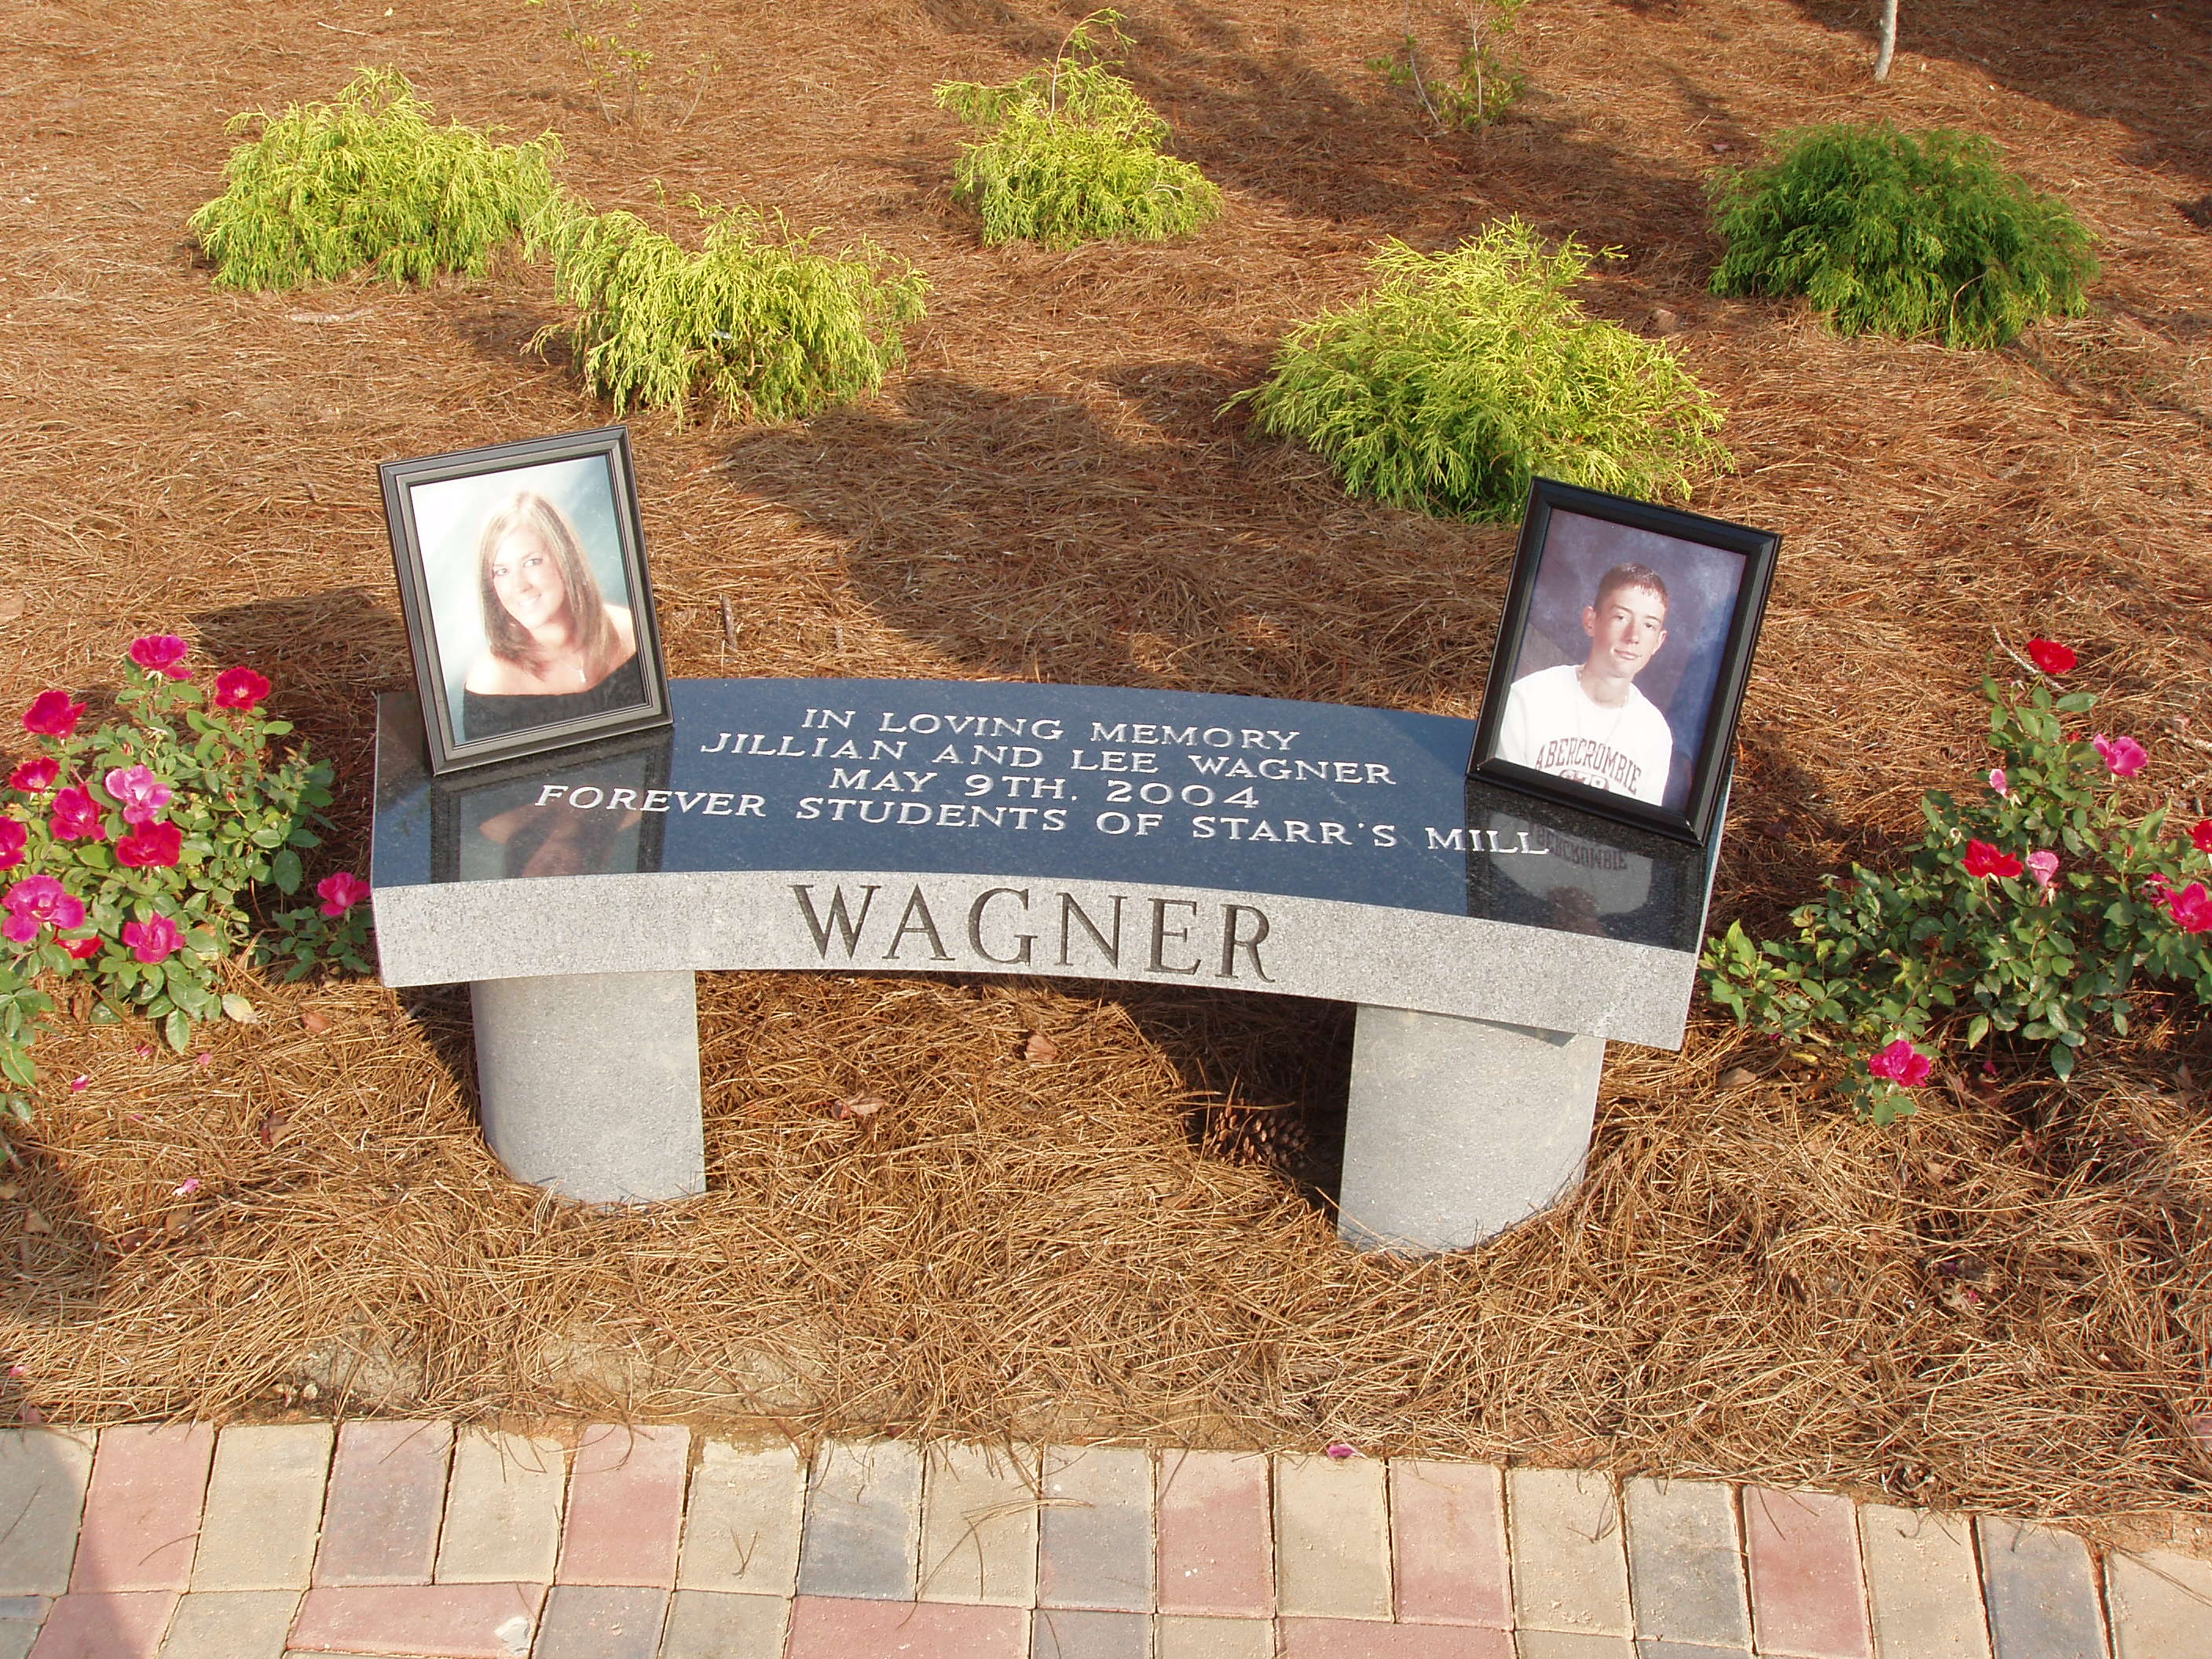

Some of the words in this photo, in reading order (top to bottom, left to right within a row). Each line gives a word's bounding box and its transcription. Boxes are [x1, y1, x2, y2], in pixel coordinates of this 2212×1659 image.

[801, 709, 855, 730] IN
[877, 712, 1063, 740] LOVING
[1091, 722, 1301, 751] MEMORY
[701, 733, 908, 760] JILLIAN
[936, 745, 1043, 768] AND
[1071, 749, 1159, 774] LEE
[1187, 755, 1397, 785] WAGNER
[1535, 737, 1642, 795] ABERCROMBIE
[830, 767, 938, 793] MAY
[1106, 780, 1260, 808] 2004
[534, 785, 767, 818] FOREVER
[796, 797, 1068, 832] STUDENTS
[1096, 811, 1164, 837] OF
[1192, 815, 1398, 849] STARR'S
[1426, 827, 1550, 855] MILL
[788, 883, 1276, 984] WAGNER
